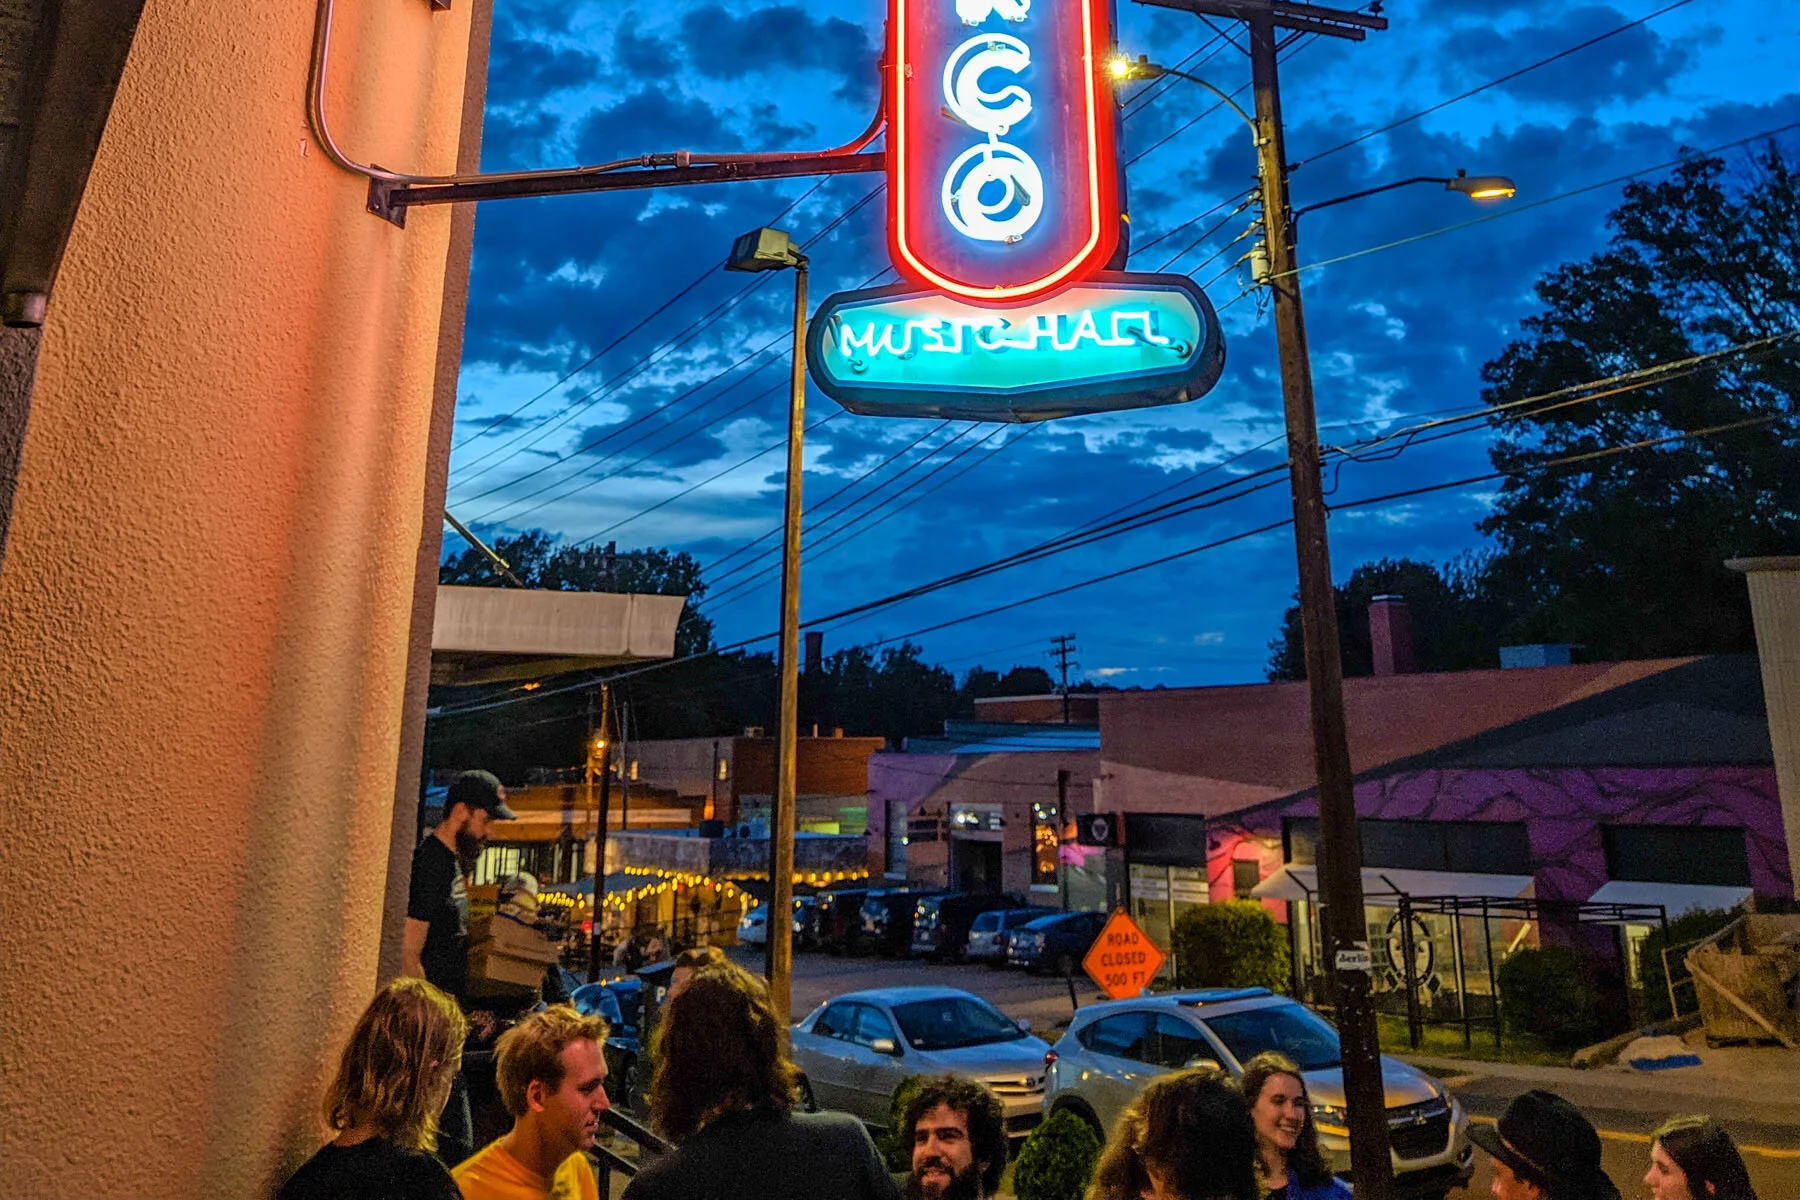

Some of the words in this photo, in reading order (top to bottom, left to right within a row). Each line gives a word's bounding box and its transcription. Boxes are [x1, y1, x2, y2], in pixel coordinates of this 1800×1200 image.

[840, 317, 1011, 356] MUSIC
[1031, 310, 1169, 351] HALL
[1107, 932, 1139, 945] ROAD
[1101, 951, 1146, 966] CLOSED
[1105, 972, 1127, 987] 500
[1132, 971, 1145, 984] FT
